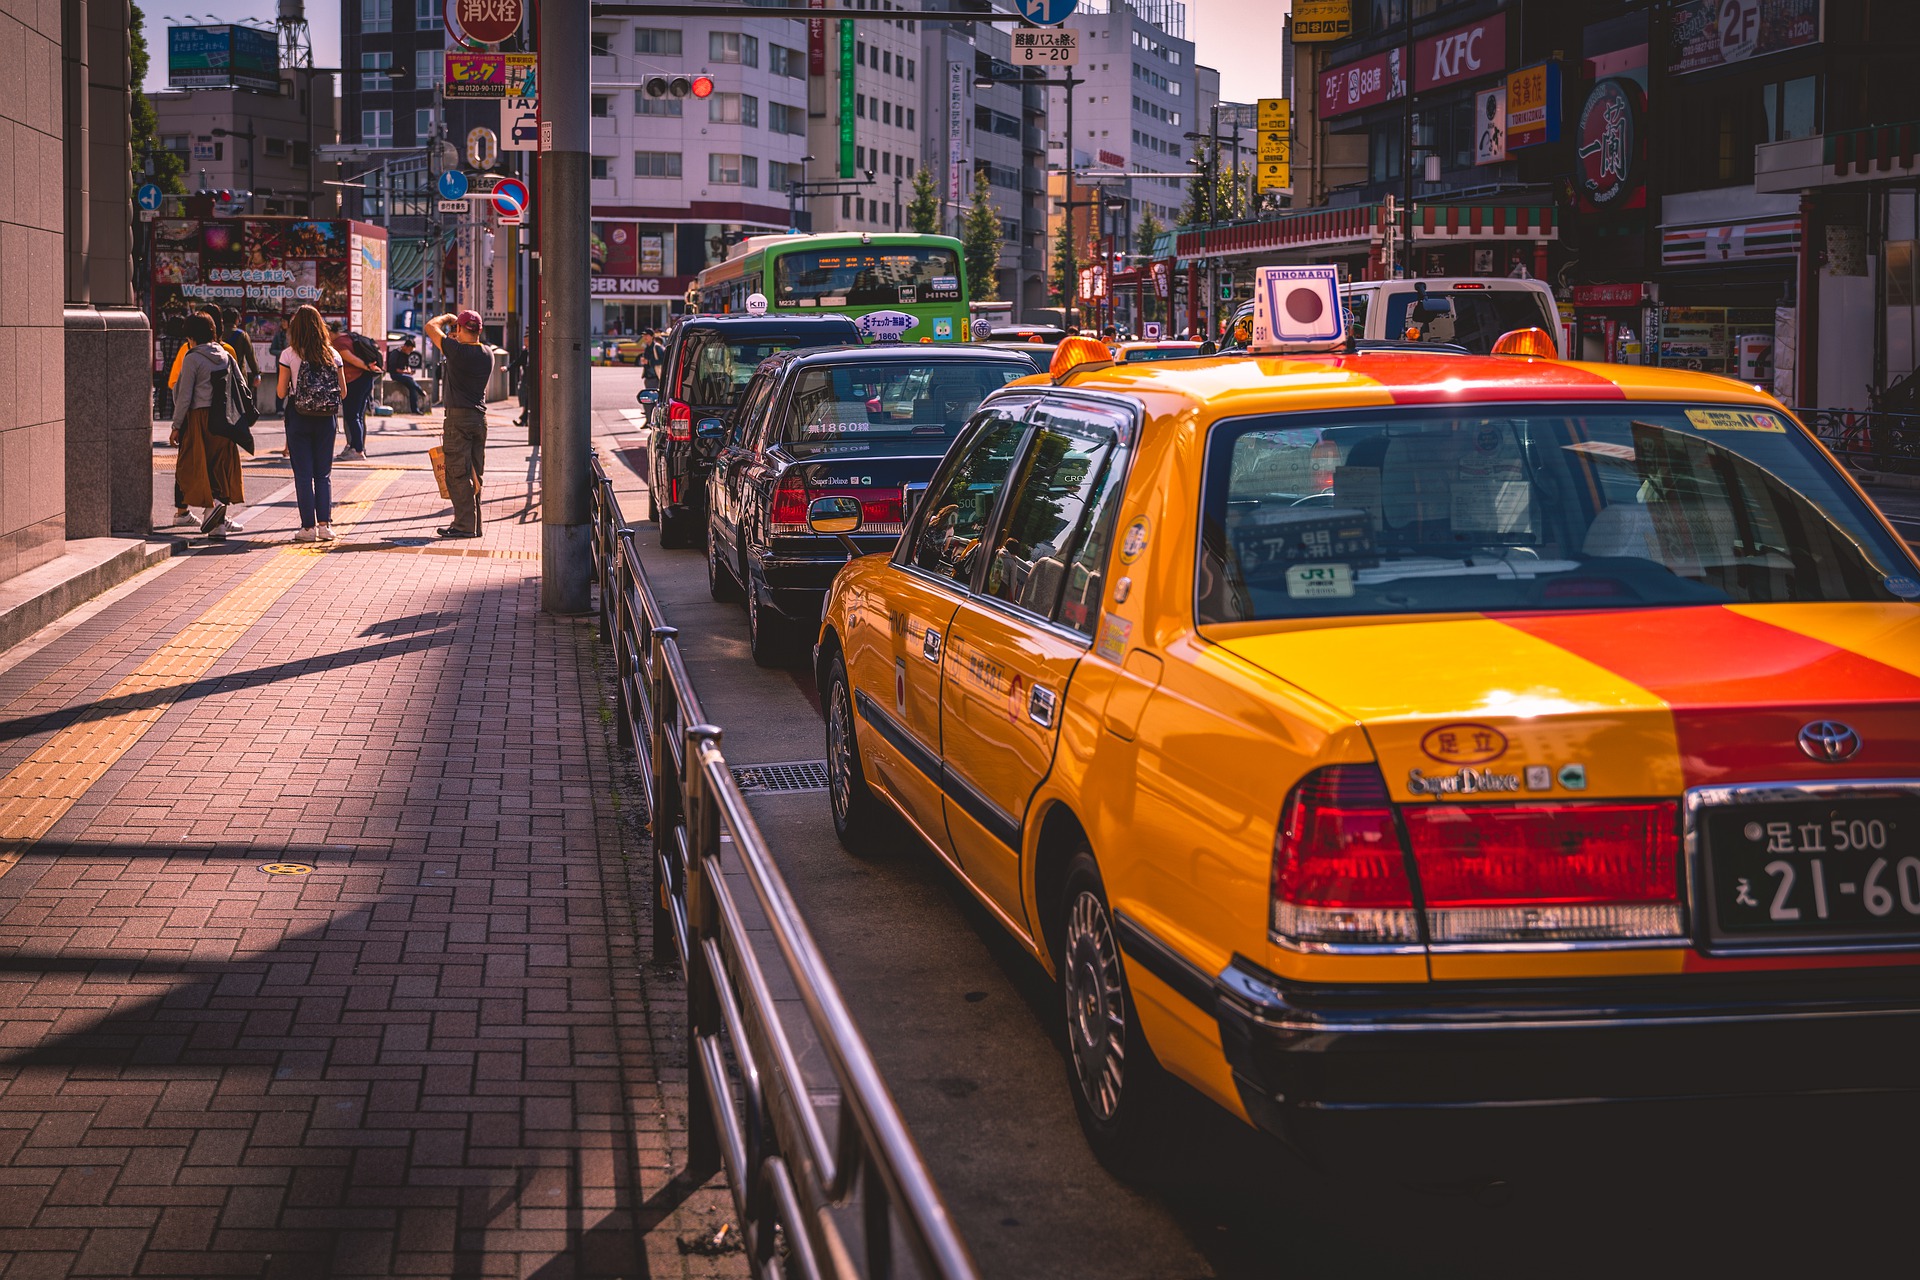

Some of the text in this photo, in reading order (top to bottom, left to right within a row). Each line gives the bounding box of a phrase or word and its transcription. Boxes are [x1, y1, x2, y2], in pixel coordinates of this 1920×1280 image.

[463, 0, 517, 22] 消火栓
[1295, 20, 1350, 34] 神谷バー
[1015, 34, 1076, 46] 路線バスを除く
[1432, 27, 1484, 81] KFC
[451, 61, 497, 81] ビッグ
[1326, 67, 1381, 99] 2F 88席
[1260, 146, 1287, 154] レストラン
[209, 269, 296, 283] ようこそ台東区へ
[1268, 270, 1331, 280] HINOMARU
[181, 284, 323, 301] Welcome to Taito City
[620, 278, 660, 293] KING
[925, 291, 959, 299] HINO
[871, 317, 905, 327] チェッカー無線
[878, 332, 898, 340] 1860
[808, 422, 870, 434] 無1860線
[811, 476, 848, 486] Super Deluxe
[1438, 731, 1495, 755] 足立
[1408, 767, 1520, 800] Super Deluxe
[1766, 819, 1887, 853] 足立 500
[1735, 856, 1920, 921] え 21-60
